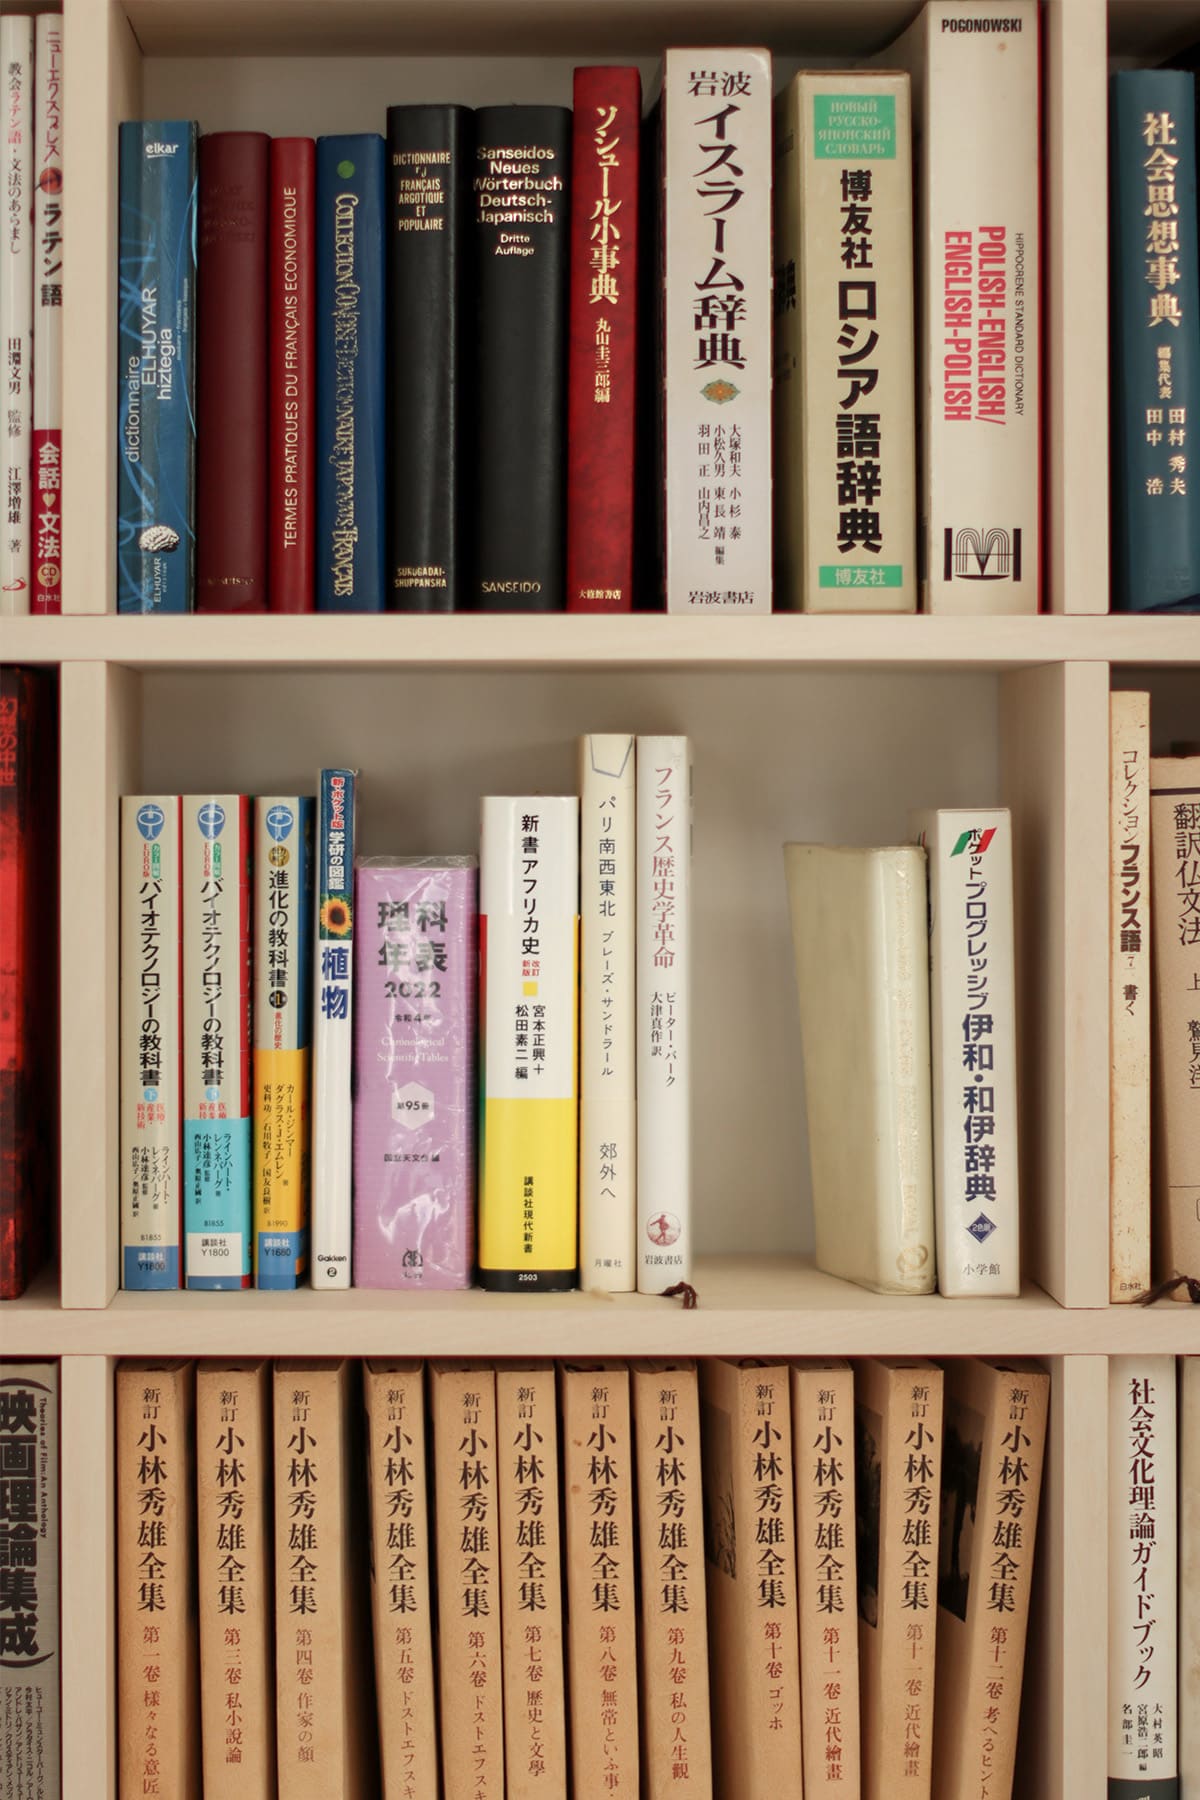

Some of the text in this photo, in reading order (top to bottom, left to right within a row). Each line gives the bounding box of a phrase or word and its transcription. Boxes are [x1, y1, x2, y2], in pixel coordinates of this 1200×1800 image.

[941, 18, 1022, 33] POGONOWSKI
[688, 71, 751, 97] 岩波
[830, 102, 878, 113] НОВЫЙ
[818, 128, 891, 141] ЯПОНСКИЙ
[828, 115, 881, 128] РУССКО-
[146, 142, 179, 155] elkar
[393, 152, 451, 166] DICTIONNAIRE
[477, 146, 555, 160] Sanseidos
[490, 161, 540, 174] Neues
[825, 143, 885, 155] СЛОВАРЬ
[399, 192, 444, 204] ARGOTIQUE
[400, 178, 440, 192] FRANÇAIS
[473, 177, 563, 191] Wörterbuch
[480, 194, 552, 207] Deutsch-
[589, 105, 622, 304] ソシュール小事典
[399, 219, 444, 231] POPULAIRE
[416, 206, 425, 217] ET
[477, 210, 553, 225] Japanisch
[692, 104, 747, 370] イスラーム辞典
[840, 169, 873, 270] 博友社
[1142, 112, 1182, 327] 社会思想事典
[42, 203, 62, 307] ラテン語
[495, 245, 535, 256] Auflage
[500, 233, 530, 243] Dritte
[142, 288, 157, 385] ELHUYAR
[944, 231, 972, 420] ENGLISH-POLISH
[975, 226, 1006, 425] POLISH-ENGLISH/
[1015, 233, 1025, 416] HIPPOCRENE STANDARD DICTIONARY
[158, 329, 175, 400] hiztegia
[284, 188, 299, 548] TERMES PRATIQUES DU FRANÇAIS ECONOMIQUE
[1157, 347, 1172, 399] 編集代表
[125, 357, 140, 463] dictionnaire
[836, 281, 882, 554] ロシア語辞典
[714, 424, 726, 477] 小松久男
[729, 424, 741, 477] 大塚和夫
[38, 442, 61, 559] 会話 文法
[698, 487, 710, 540] 山内昌之
[394, 578, 447, 588] SHUPPANSHA
[482, 582, 542, 593] SANSEIDO
[688, 591, 754, 605] 岩波書店
[835, 568, 886, 585] 博友社
[329, 832, 345, 890] 学研の図鑑
[599, 796, 616, 916] パリ南西東北
[652, 768, 675, 968] フランス歴史学革命
[968, 828, 982, 880] ポケット
[521, 814, 540, 955] 新書アフリカ史
[1120, 844, 1141, 952] フランス語
[268, 870, 289, 987] 進化の教科書
[378, 901, 448, 932] 理科
[378, 941, 448, 972] 年表
[965, 882, 989, 1010] プログレッシブ
[139, 879, 162, 1086] バイオテクノロジーの教科書
[200, 878, 224, 1086] バイオテクノロジーの教科書
[321, 947, 349, 1020] 植物
[385, 982, 441, 998] 2022
[1123, 984, 1138, 1016] 書く
[651, 992, 662, 1042] 大津真作
[422, 1052, 449, 1062] Tables
[600, 1143, 617, 1198] 郊外へ
[523, 1176, 534, 1253] 講談社現代新書
[138, 1253, 164, 1261] 講談社
[202, 1238, 226, 1247] 講談社
[202, 1248, 229, 1257] Y1800
[264, 1238, 290, 1247] 講談社
[317, 1255, 347, 1263] Gakken
[594, 1259, 623, 1267] 月曜社
[645, 1255, 682, 1265] 岩波書店
[963, 1263, 1001, 1275] 小学館
[1120, 1282, 1141, 1291] 白水社
[40, 1439, 47, 1451] of
[40, 1493, 48, 1538] Anthology
[137, 1387, 168, 1612] 新訂 小林秀雄全集
[215, 1390, 246, 1615] 新訂 小林秀雄全集
[287, 1390, 318, 1615] 新訂 小林秀雄全集
[383, 1389, 418, 1613] 新訂 小林秀雄全集
[459, 1392, 490, 1617] 新訂 小林秀雄全集
[513, 1387, 547, 1612] 新訂 小林秀雄全集
[587, 1387, 621, 1612] 新訂 小林秀雄全集
[655, 1390, 689, 1614] 新訂 小林秀雄全集
[752, 1384, 787, 1608] 新訂 小林秀雄全集
[813, 1389, 845, 1613] 新訂 小林秀雄全集
[901, 1385, 935, 1610] 新訂 小林秀雄全集
[986, 1388, 1031, 1612] 新訂 小林秀雄全集
[1128, 1378, 1155, 1690] 社会文化理論ガイドブック
[768, 1686, 784, 1730] ゴッホ
